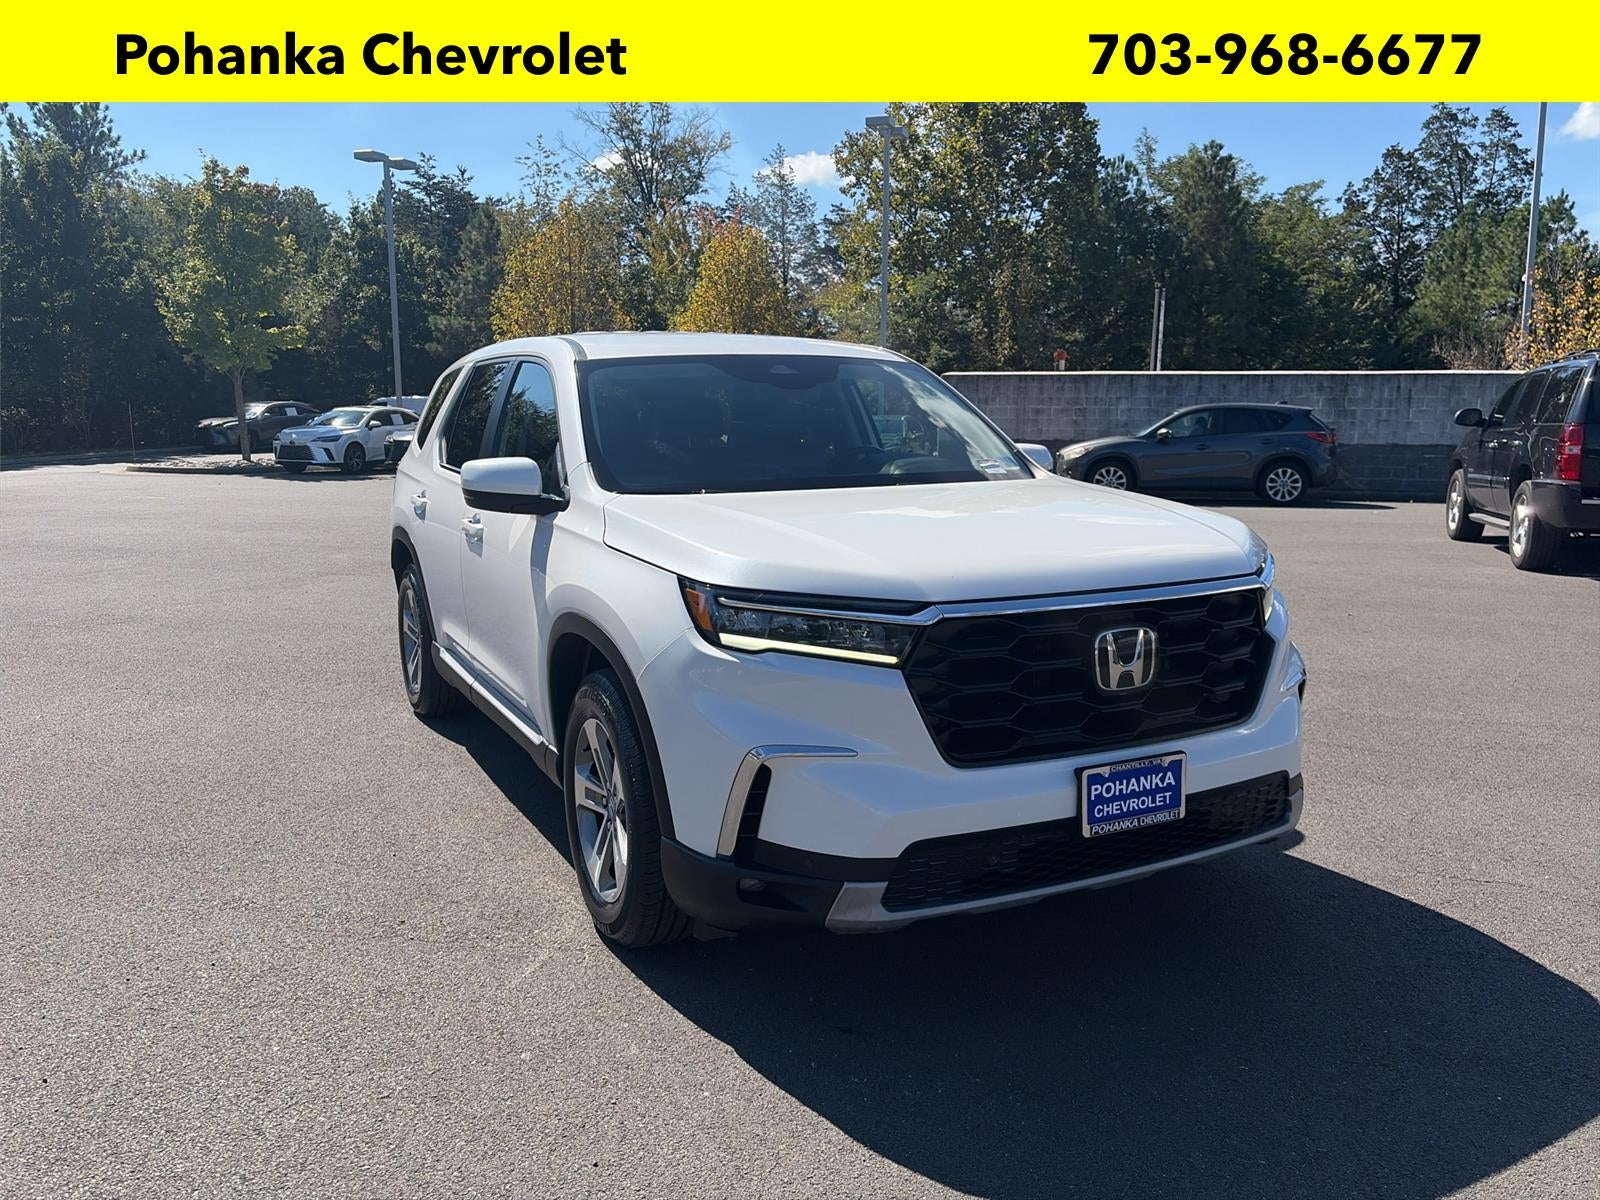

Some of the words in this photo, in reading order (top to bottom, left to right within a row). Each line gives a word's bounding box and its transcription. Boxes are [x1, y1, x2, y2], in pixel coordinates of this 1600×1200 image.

[1091, 771, 1176, 800] POHANKA
[1094, 792, 1172, 818] CHEVROLET
[1092, 819, 1139, 835] POHANKA
[1140, 810, 1179, 826] CHEVROLET
